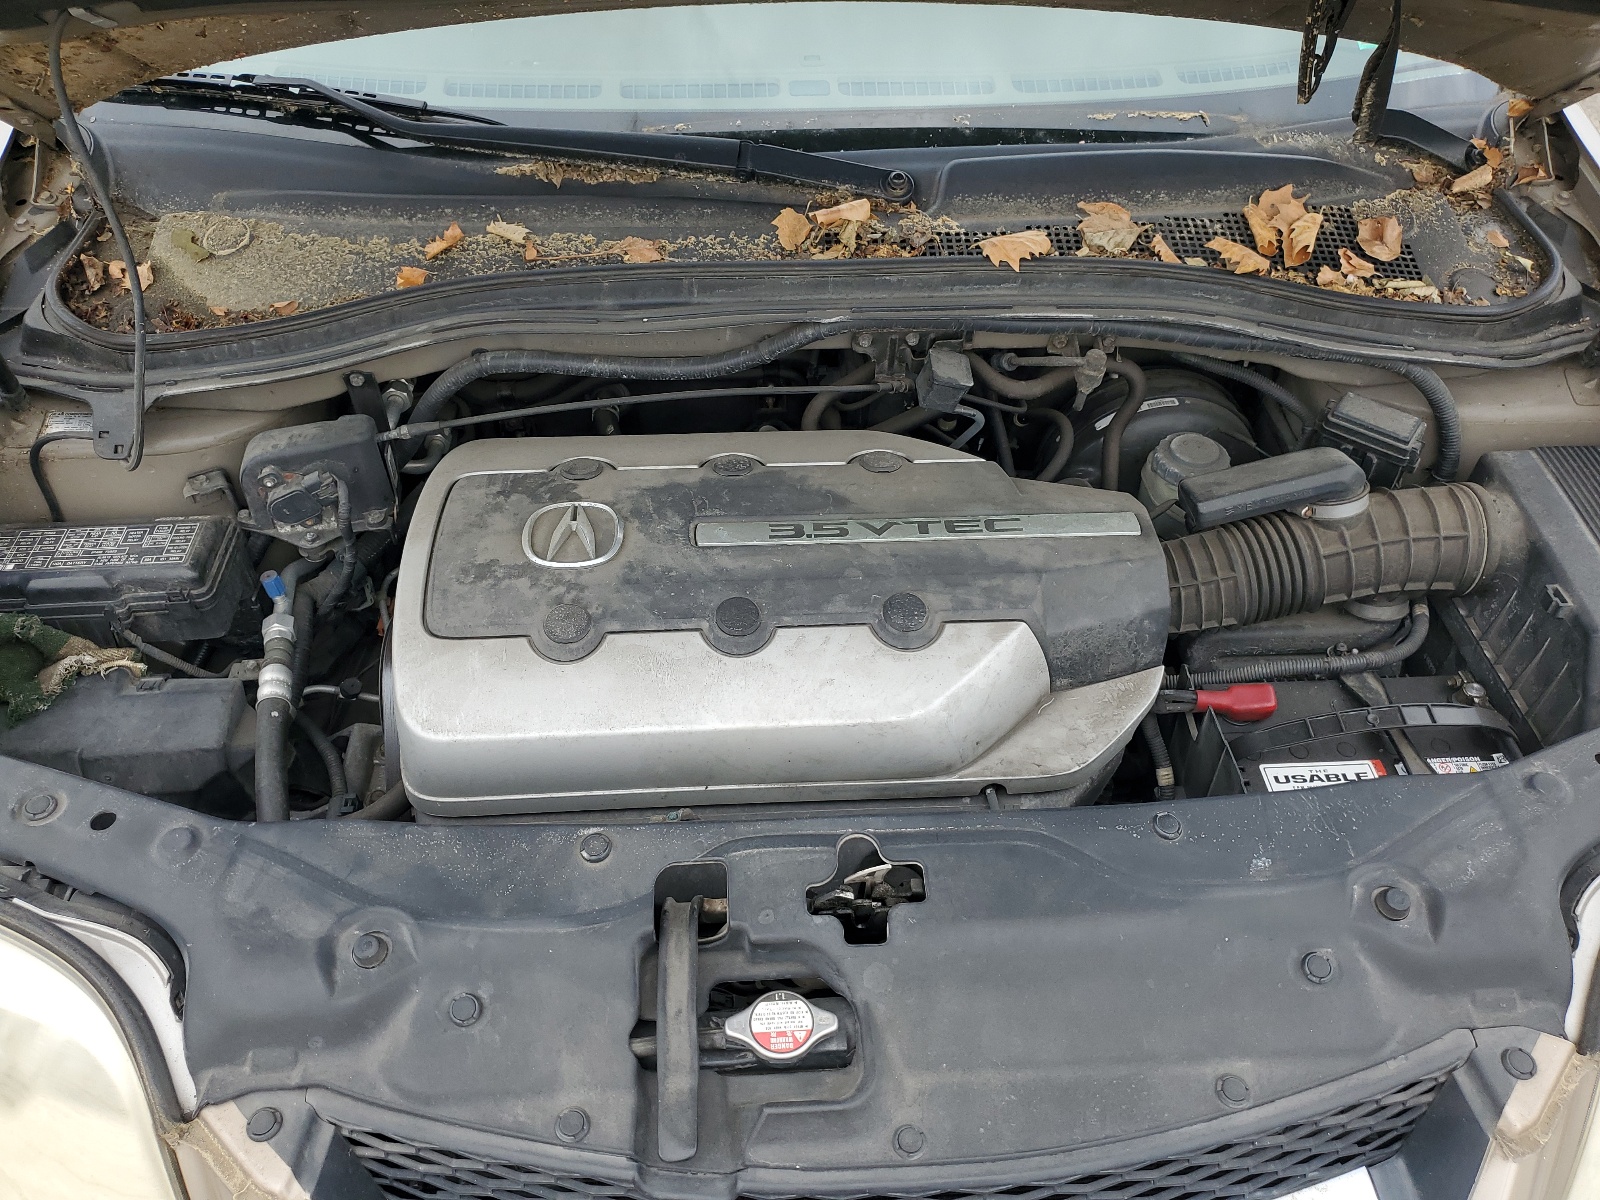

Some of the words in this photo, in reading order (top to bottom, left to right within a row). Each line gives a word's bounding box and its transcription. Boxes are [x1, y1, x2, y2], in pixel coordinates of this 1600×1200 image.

[768, 522, 849, 540] 3.5
[854, 517, 1024, 537] VTEC
[1272, 772, 1369, 785] USABLE
